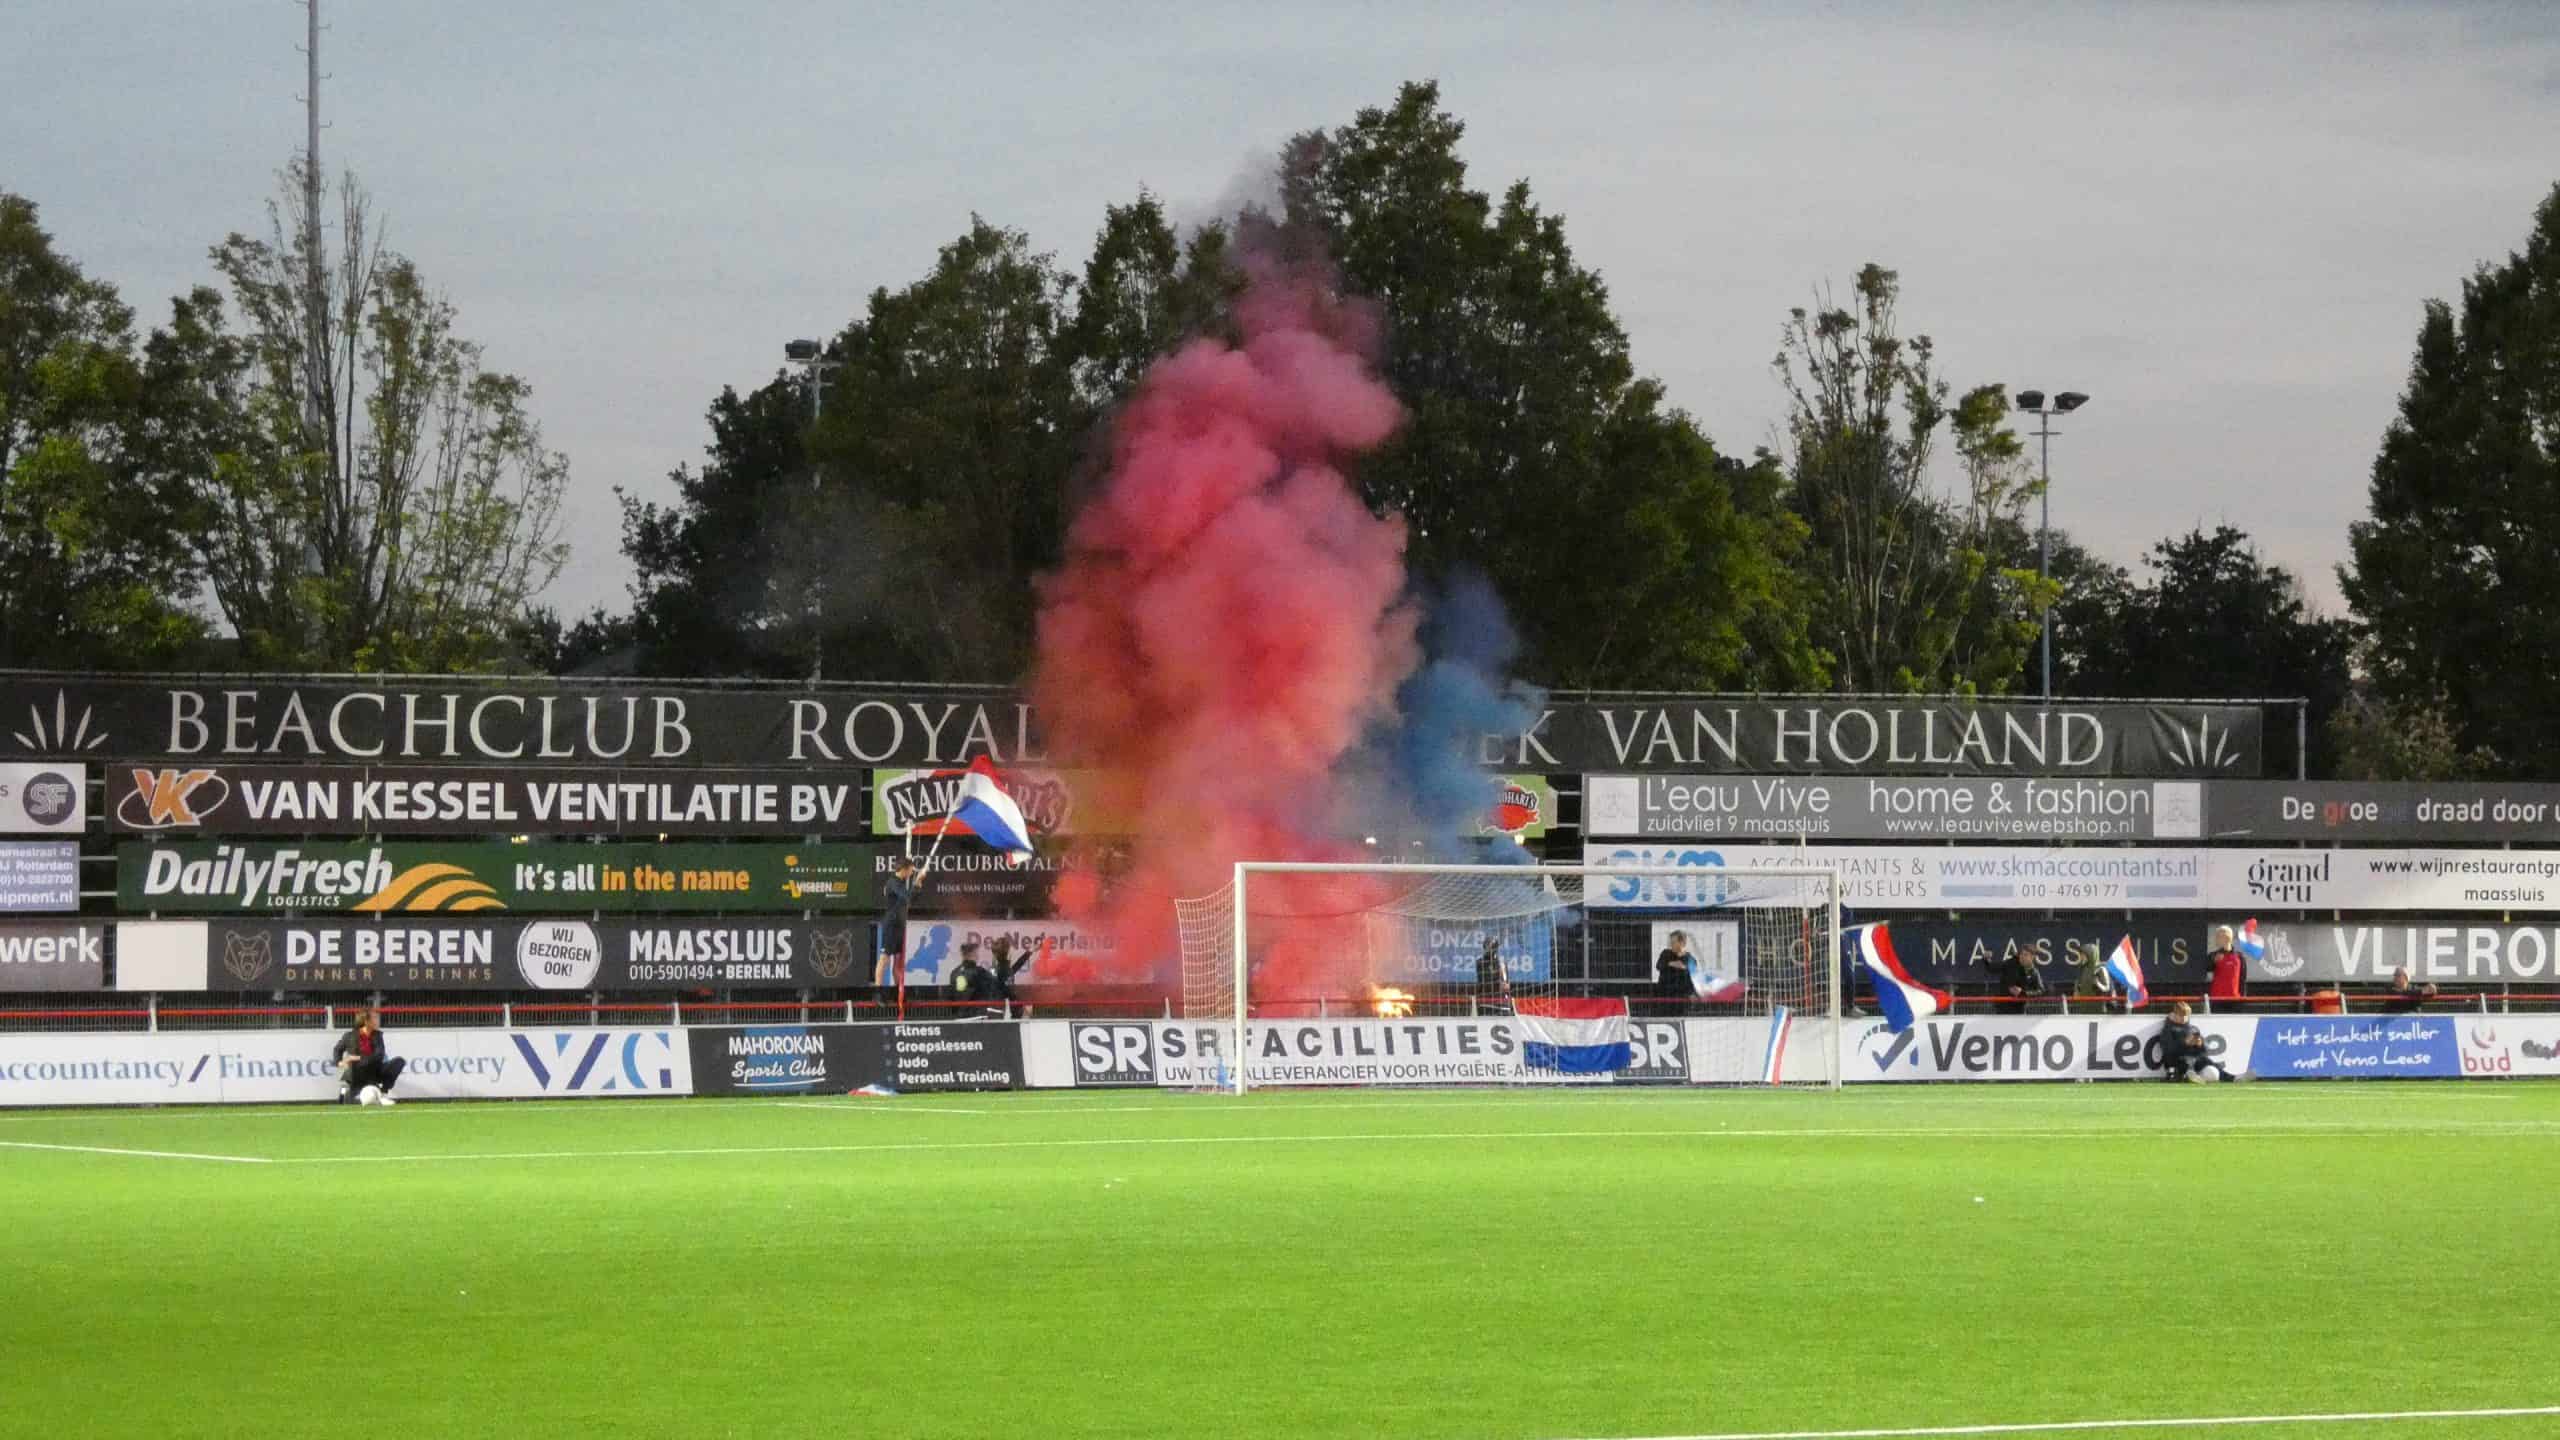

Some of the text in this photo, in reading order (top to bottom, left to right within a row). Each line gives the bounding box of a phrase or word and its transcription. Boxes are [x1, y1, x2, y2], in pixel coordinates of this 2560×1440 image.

[167, 690, 692, 758] BEACHCLUB
[788, 700, 1048, 764] ROYAL
[1598, 708, 1740, 765] VAN
[1773, 708, 2104, 766] HOLLAND
[240, 781, 849, 822] VAN KESSEL VENTILATIE BV
[1645, 778, 1831, 813] L'eau Vive
[1869, 780, 2150, 816] home & fashion
[2282, 796, 2315, 820] De
[2416, 798, 2484, 822] draad
[2492, 798, 2547, 822] door
[1647, 816, 1831, 834] zuidvliet 9 maassluis
[1886, 816, 2136, 838] www.leauvivewebshop.nl
[144, 845, 393, 906] DailyFresh
[515, 862, 750, 892] It's all in the name
[1911, 857, 1926, 876] &
[1939, 855, 2199, 877] www.skmaccountants.nl
[2247, 852, 2330, 890] grand
[266, 895, 341, 907] LOGISTICS
[2022, 883, 2046, 898] 010
[2464, 887, 2546, 902] maassluis
[551, 927, 575, 943] WIJ
[629, 929, 793, 962] MAASSLUIS
[286, 929, 493, 965] DE BEREN
[528, 942, 593, 963] BEZORGEN
[286, 967, 493, 981] DINNER DRINKS
[543, 961, 574, 977] OOK!
[629, 964, 793, 981] 010-5901494 BEREN.NL
[895, 1025, 941, 1038] Fitness
[2276, 1029, 2307, 1046] Het
[729, 1035, 825, 1057] MAHOROKAN
[896, 1039, 983, 1054] Groepslessen
[1078, 1026, 1151, 1074] SR
[1927, 1022, 2074, 1073] Vemo
[897, 1056, 929, 1069] Judo
[2292, 1047, 2432, 1069] met Vemo Lease
[2462, 1047, 2512, 1073] bud
[0, 1054, 184, 1087] ccountancy
[219, 1052, 336, 1079] Finance
[731, 1059, 827, 1083] Sports Club
[898, 1070, 1011, 1085] Personal Training
[1165, 1066, 1192, 1081] UW
[1382, 1063, 1430, 1079] VOOR
